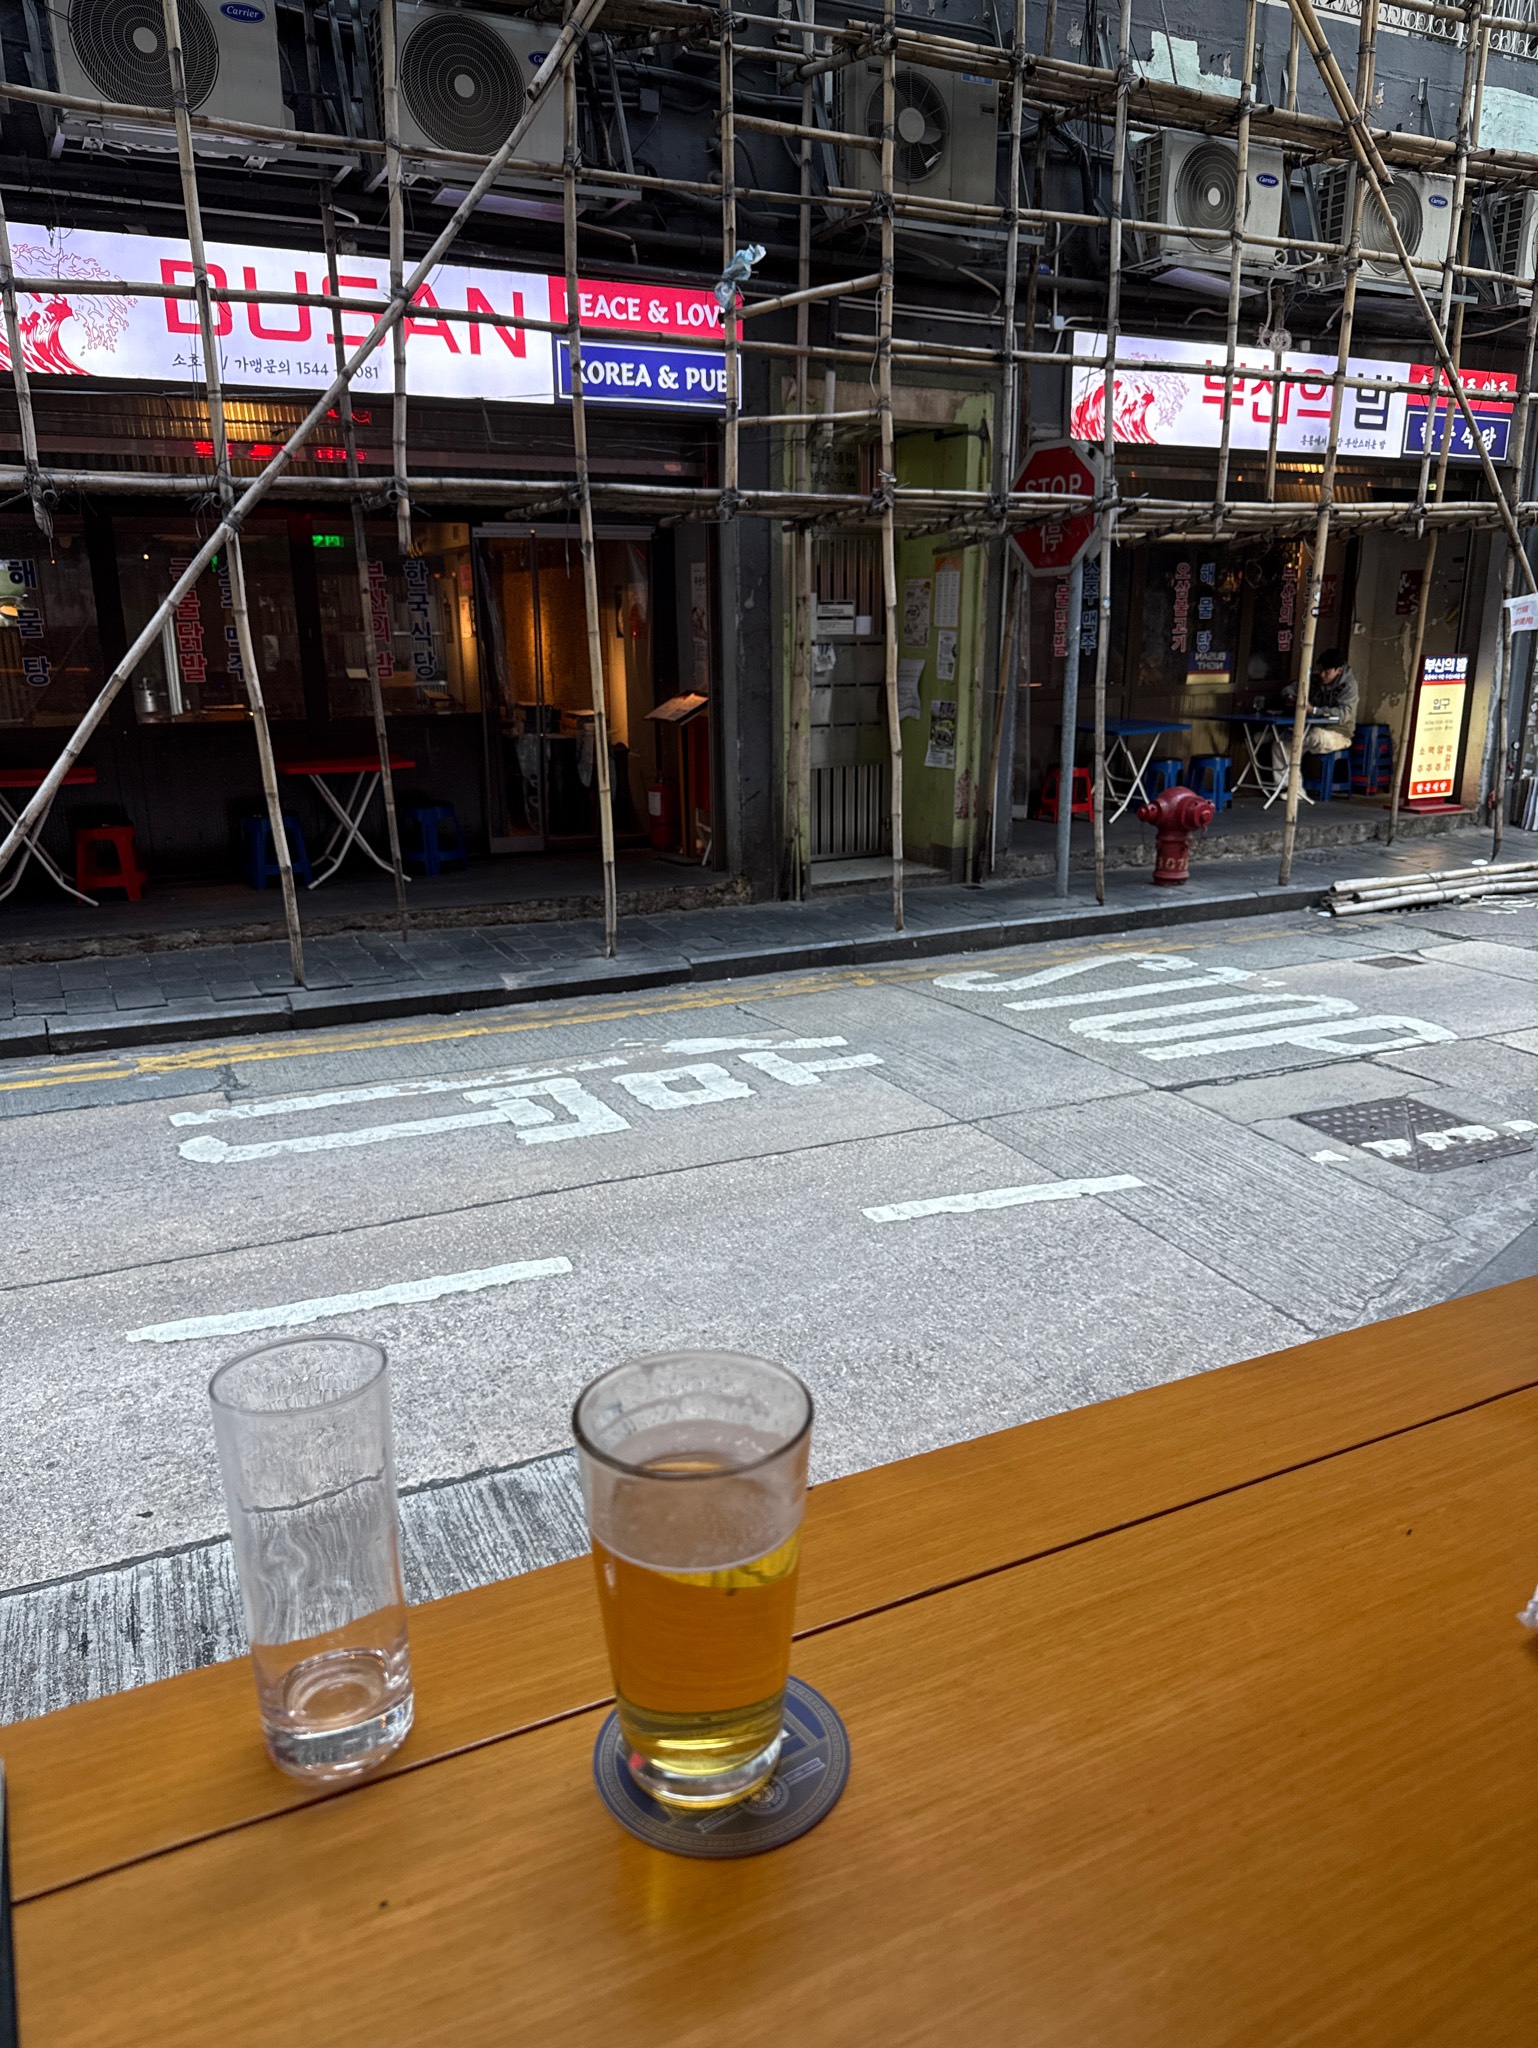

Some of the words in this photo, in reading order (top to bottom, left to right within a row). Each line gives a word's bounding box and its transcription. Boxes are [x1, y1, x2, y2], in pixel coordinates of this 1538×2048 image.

[159, 258, 527, 359] BUSAN
[647, 299, 670, 324] &
[675, 301, 726, 329] LOV
[234, 356, 291, 376] 가맹문의
[296, 361, 329, 376] 1544
[657, 364, 679, 390] &
[685, 366, 727, 393] PUB
[1040, 521, 1063, 554] 停
[367, 560, 391, 646] 부산의
[1082, 560, 1101, 606] 소주
[402, 560, 437, 681] 한국식당
[1171, 561, 1192, 654] 오삼불고기
[1079, 608, 1099, 657] 맥주
[1432, 697, 1450, 711] 입구
[931, 951, 1459, 1061] STOP
